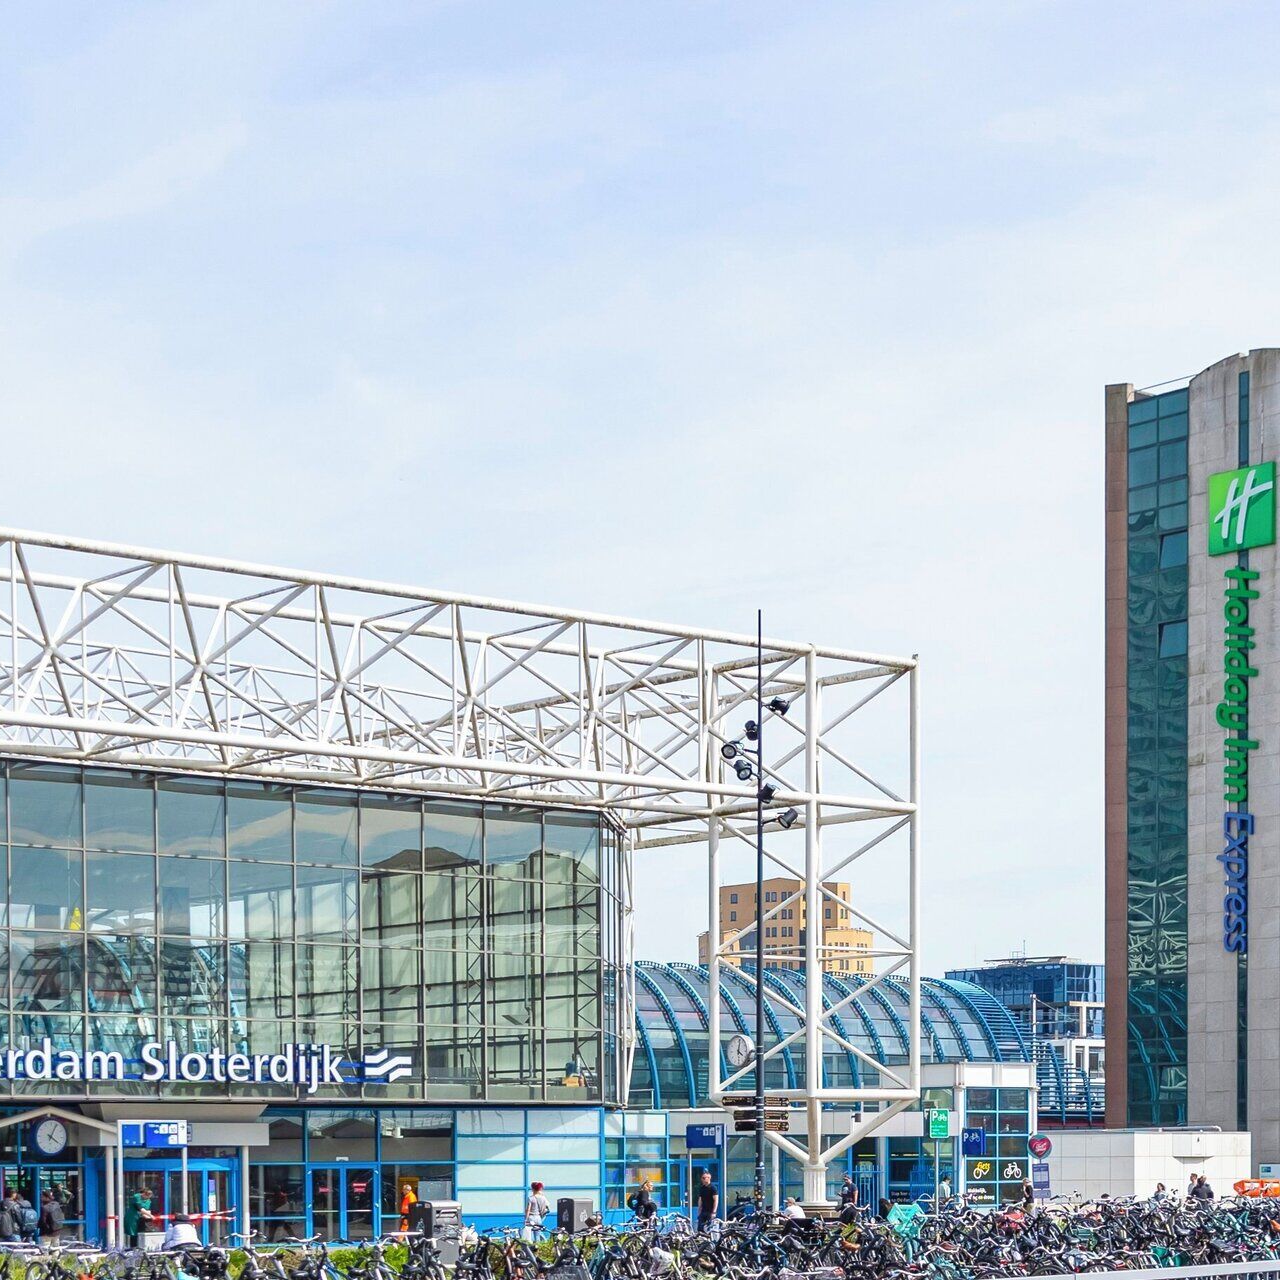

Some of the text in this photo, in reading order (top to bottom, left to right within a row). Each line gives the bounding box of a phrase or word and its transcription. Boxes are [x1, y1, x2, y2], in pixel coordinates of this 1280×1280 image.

[1216, 565, 1261, 953] Holiday Inn Express
[140, 1041, 345, 1094] Sloterdijk
